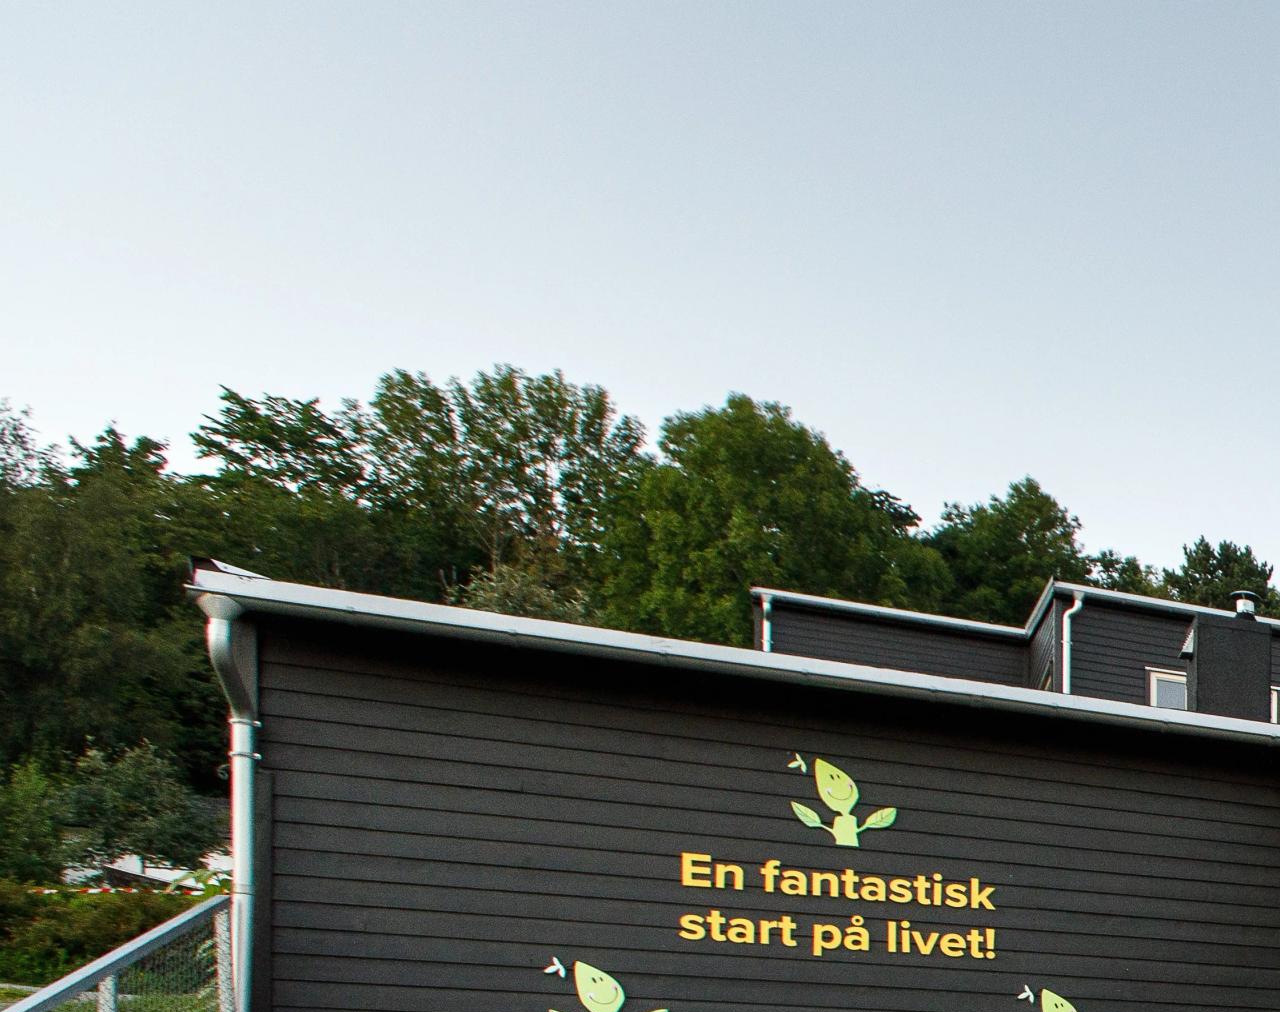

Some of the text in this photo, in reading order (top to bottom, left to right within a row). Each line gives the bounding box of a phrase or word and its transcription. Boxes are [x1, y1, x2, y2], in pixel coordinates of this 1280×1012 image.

[680, 852, 995, 910] En fantastisk
[678, 909, 996, 960] start på livet!
